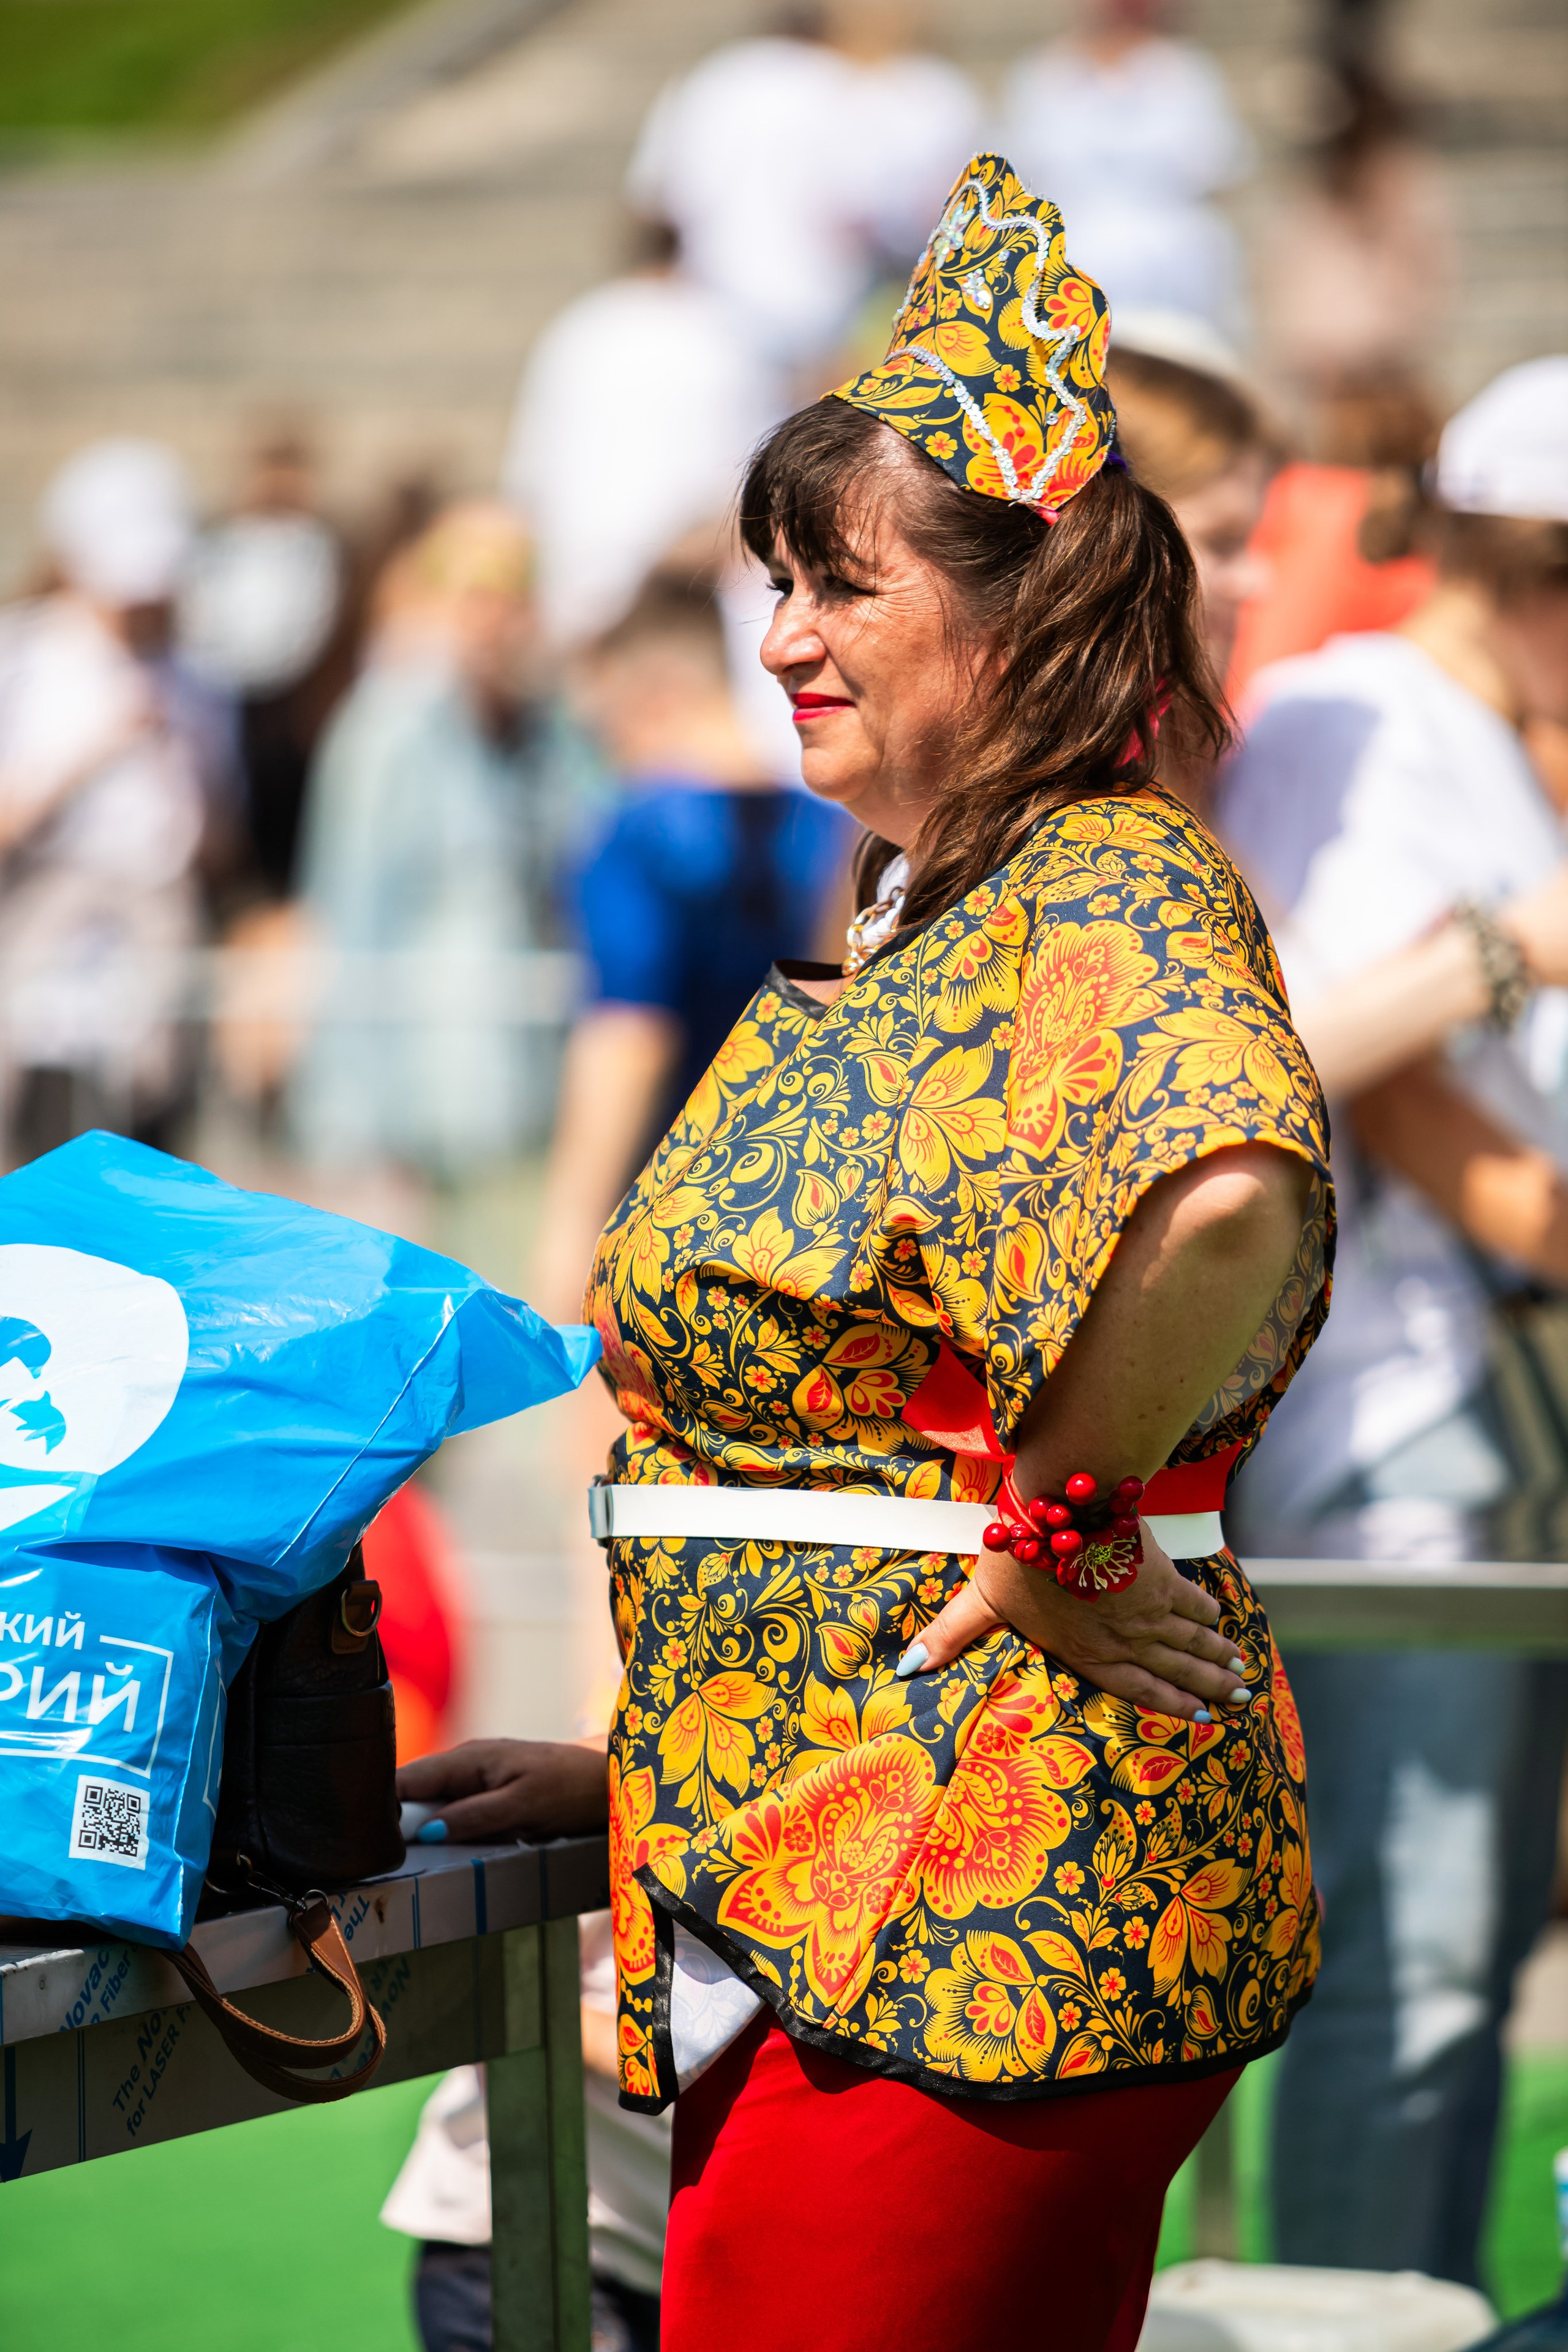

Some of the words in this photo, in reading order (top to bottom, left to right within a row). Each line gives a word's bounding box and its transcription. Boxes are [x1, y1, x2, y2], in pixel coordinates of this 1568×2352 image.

[344, 1894, 370, 1941] The
[100, 1950, 131, 2014] Fiber
[113, 2065, 140, 2112] The
[127, 2098, 146, 2137] for
[143, 2024, 180, 2100] LASER
